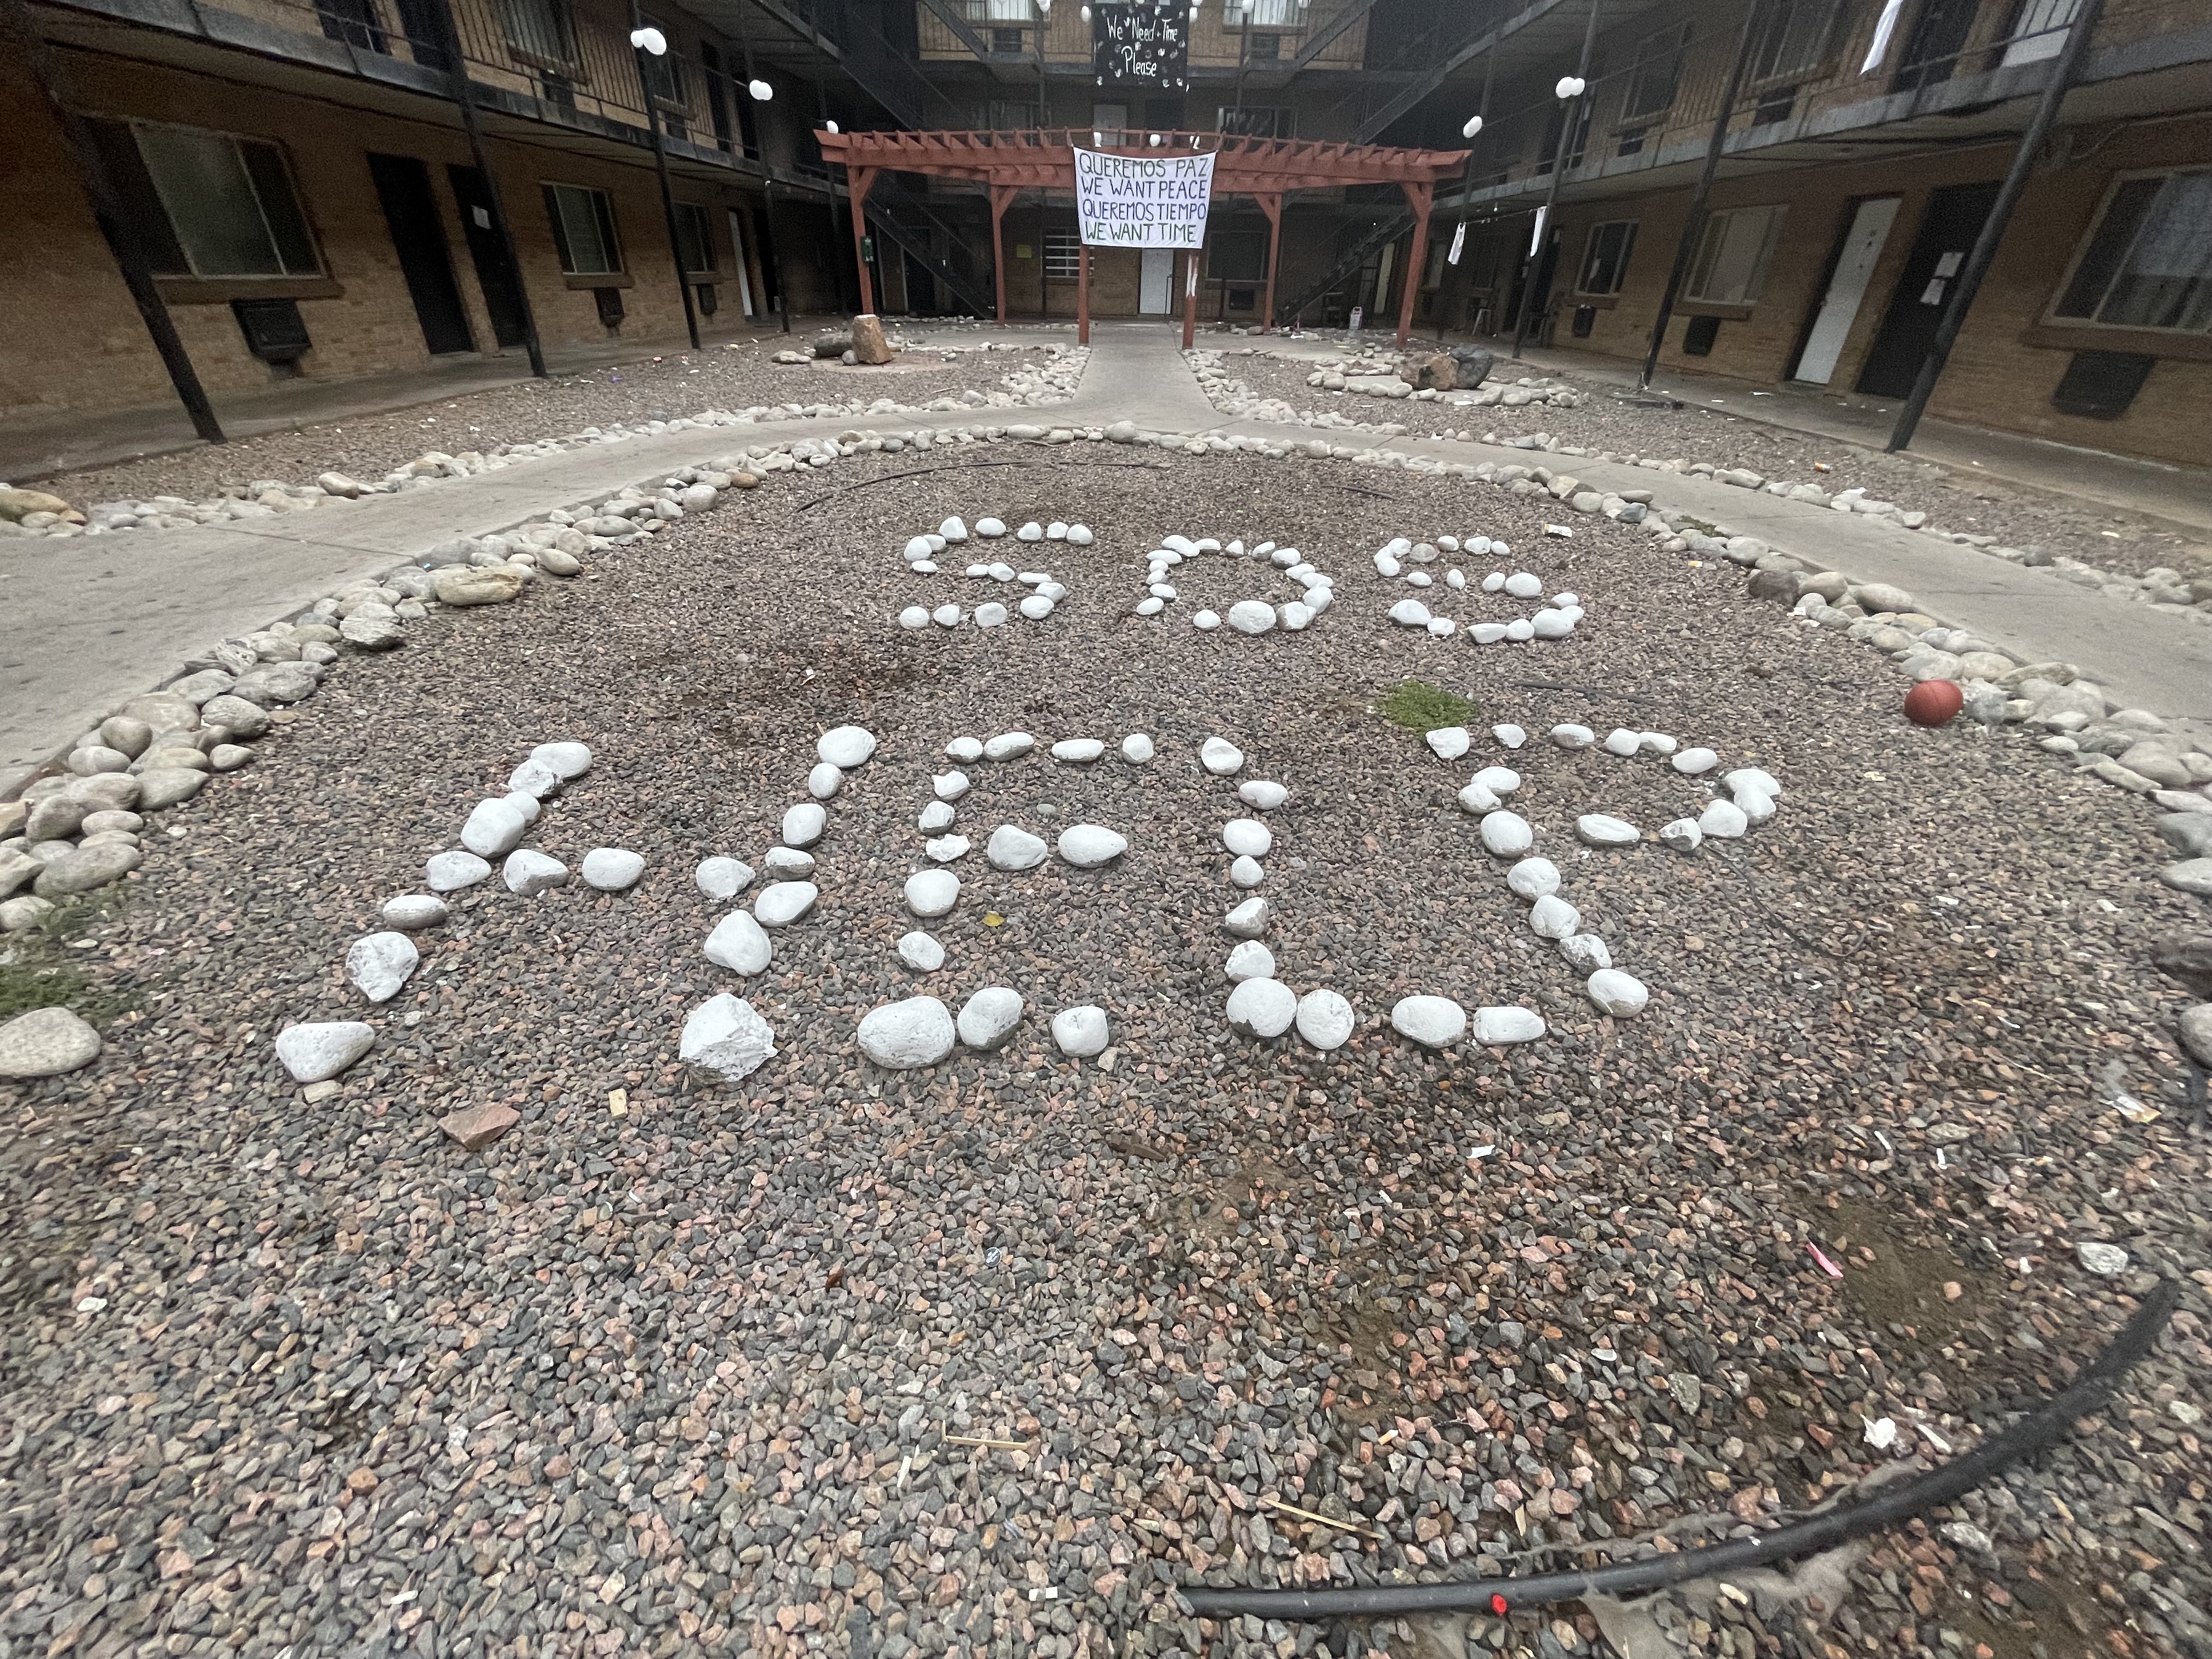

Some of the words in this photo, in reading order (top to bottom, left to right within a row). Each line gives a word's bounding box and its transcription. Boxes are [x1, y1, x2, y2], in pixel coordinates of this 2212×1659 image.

[1107, 14, 1123, 40] We
[1132, 16, 1156, 42] Need
[1161, 18, 1178, 42] Time
[1121, 46, 1157, 77] Please
[1079, 153, 1166, 178] QUEREMOS
[1176, 157, 1209, 178] PAZ
[1081, 176, 1103, 195] WE
[1109, 179, 1155, 198] WANT
[1159, 180, 1207, 199] PEACE
[1082, 199, 1154, 222] QUEREMOS
[1157, 203, 1206, 220] TIEMPO
[1086, 221, 1106, 240] WE
[1109, 223, 1154, 241] WANT
[1158, 223, 1197, 242] TIME
[899, 516, 1585, 644] SOS
[274, 724, 1782, 1086] HELP
